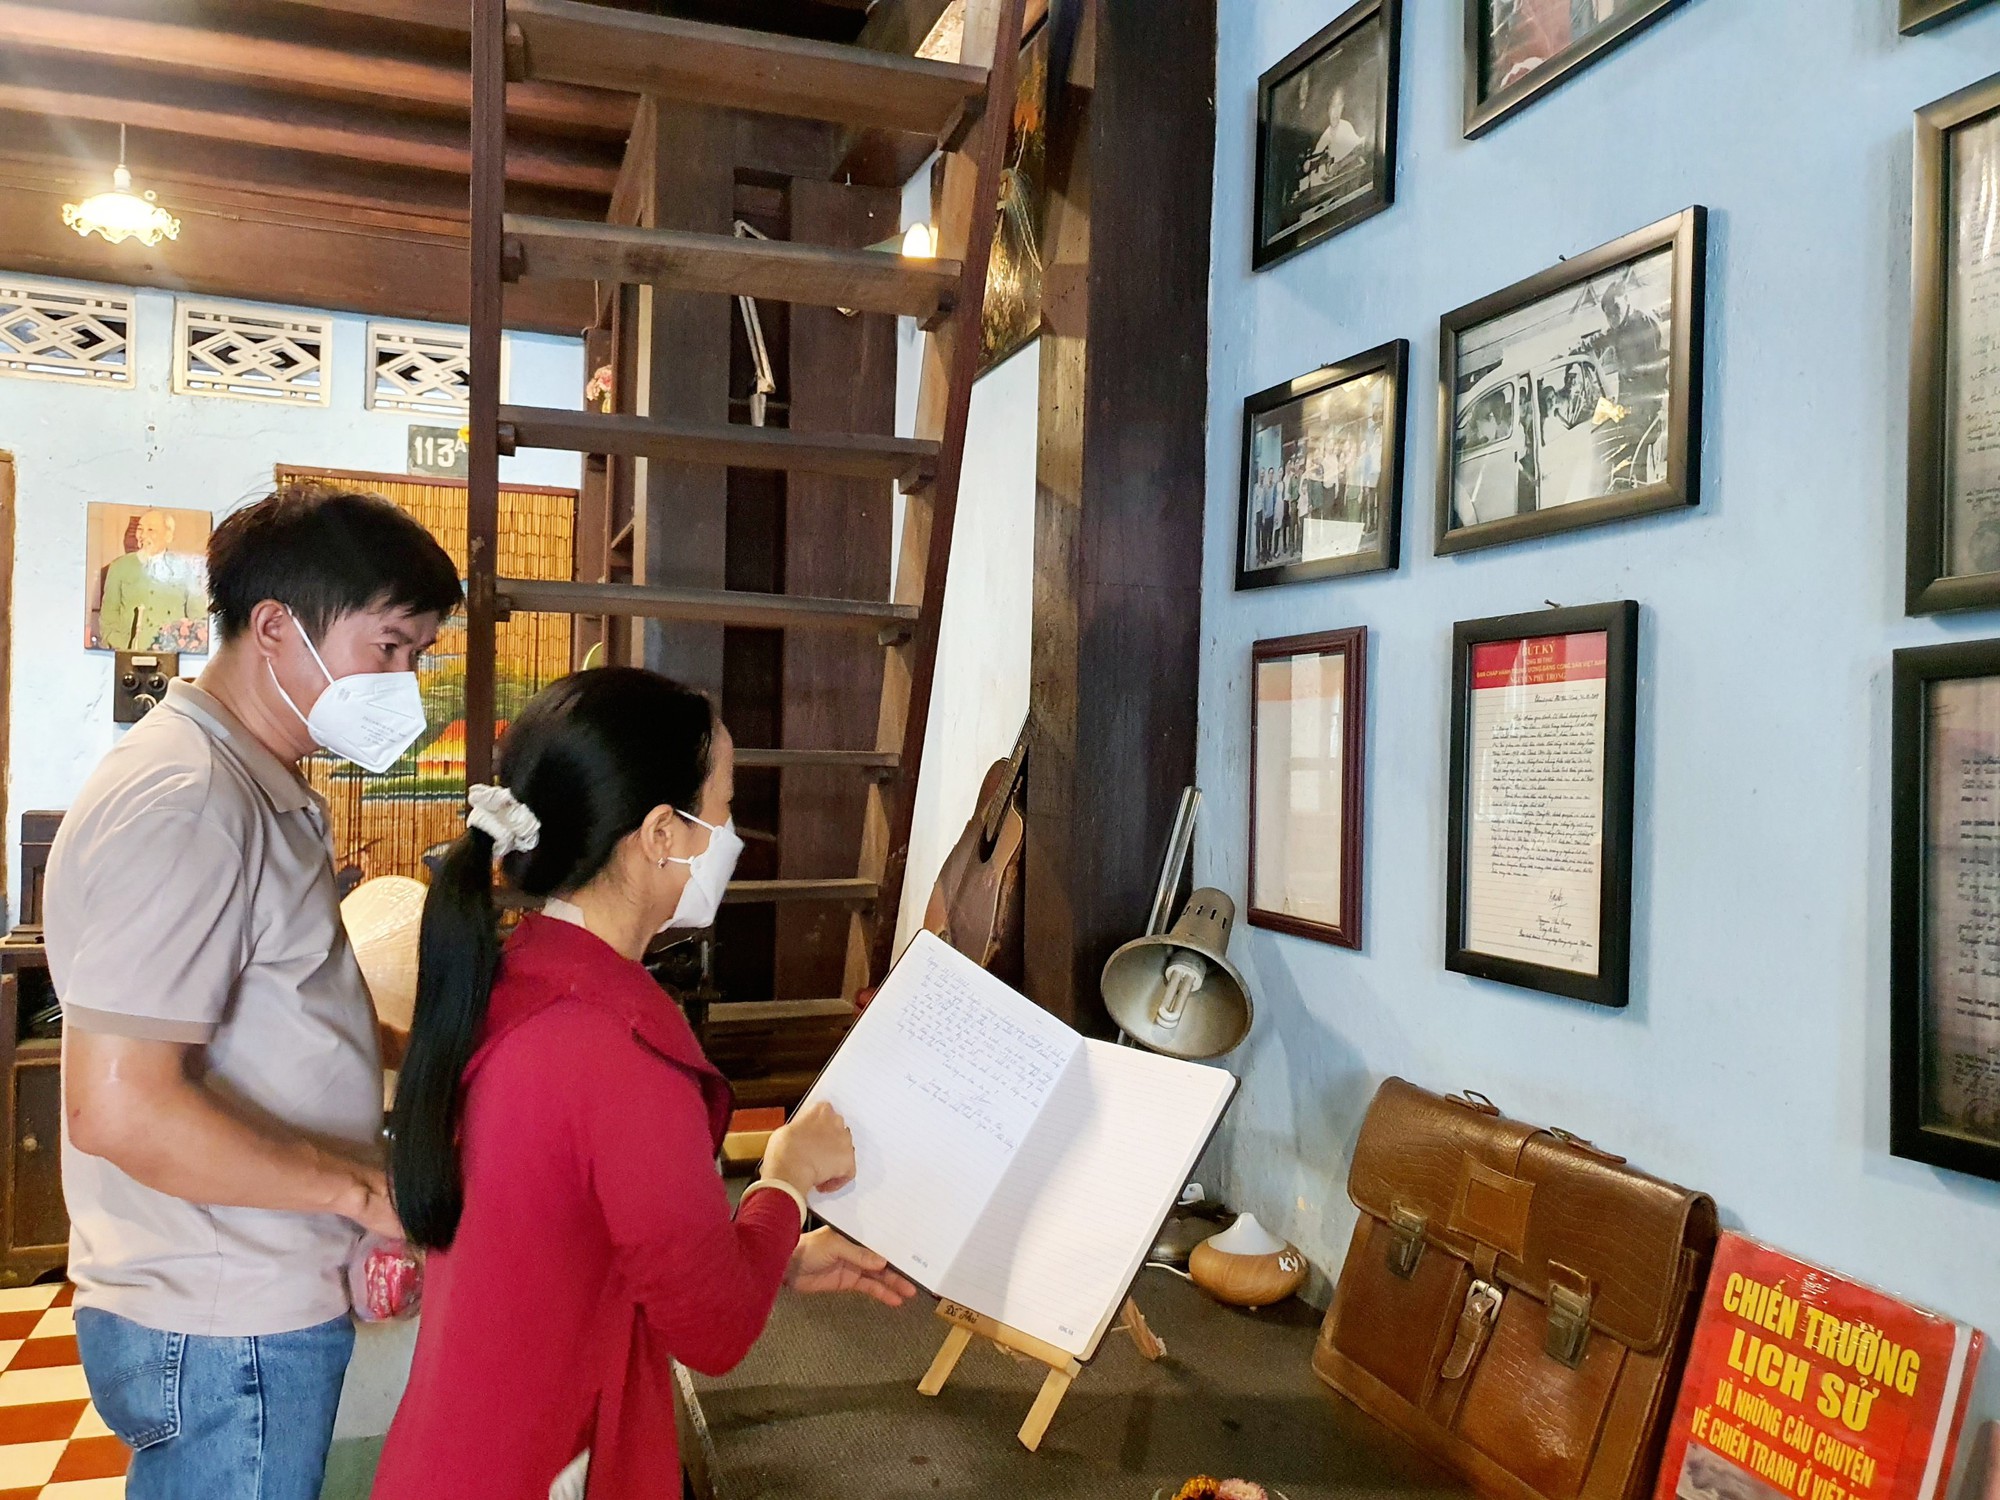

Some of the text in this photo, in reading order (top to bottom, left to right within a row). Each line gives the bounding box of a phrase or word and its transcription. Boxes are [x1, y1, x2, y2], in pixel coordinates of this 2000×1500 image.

[414, 436, 467, 468] 113A
[1723, 1272, 1920, 1397] CHIẾN TRƯỜNG
[1727, 1327, 1880, 1432] LỊCH SỬ
[1709, 1417, 1751, 1463] CHIẾN
[1750, 1440, 1798, 1491] TRANH
[1797, 1459, 1812, 1497] Ở
[1715, 1377, 1876, 1489] VÀ NHỮNG CÂU CHUYỆN
